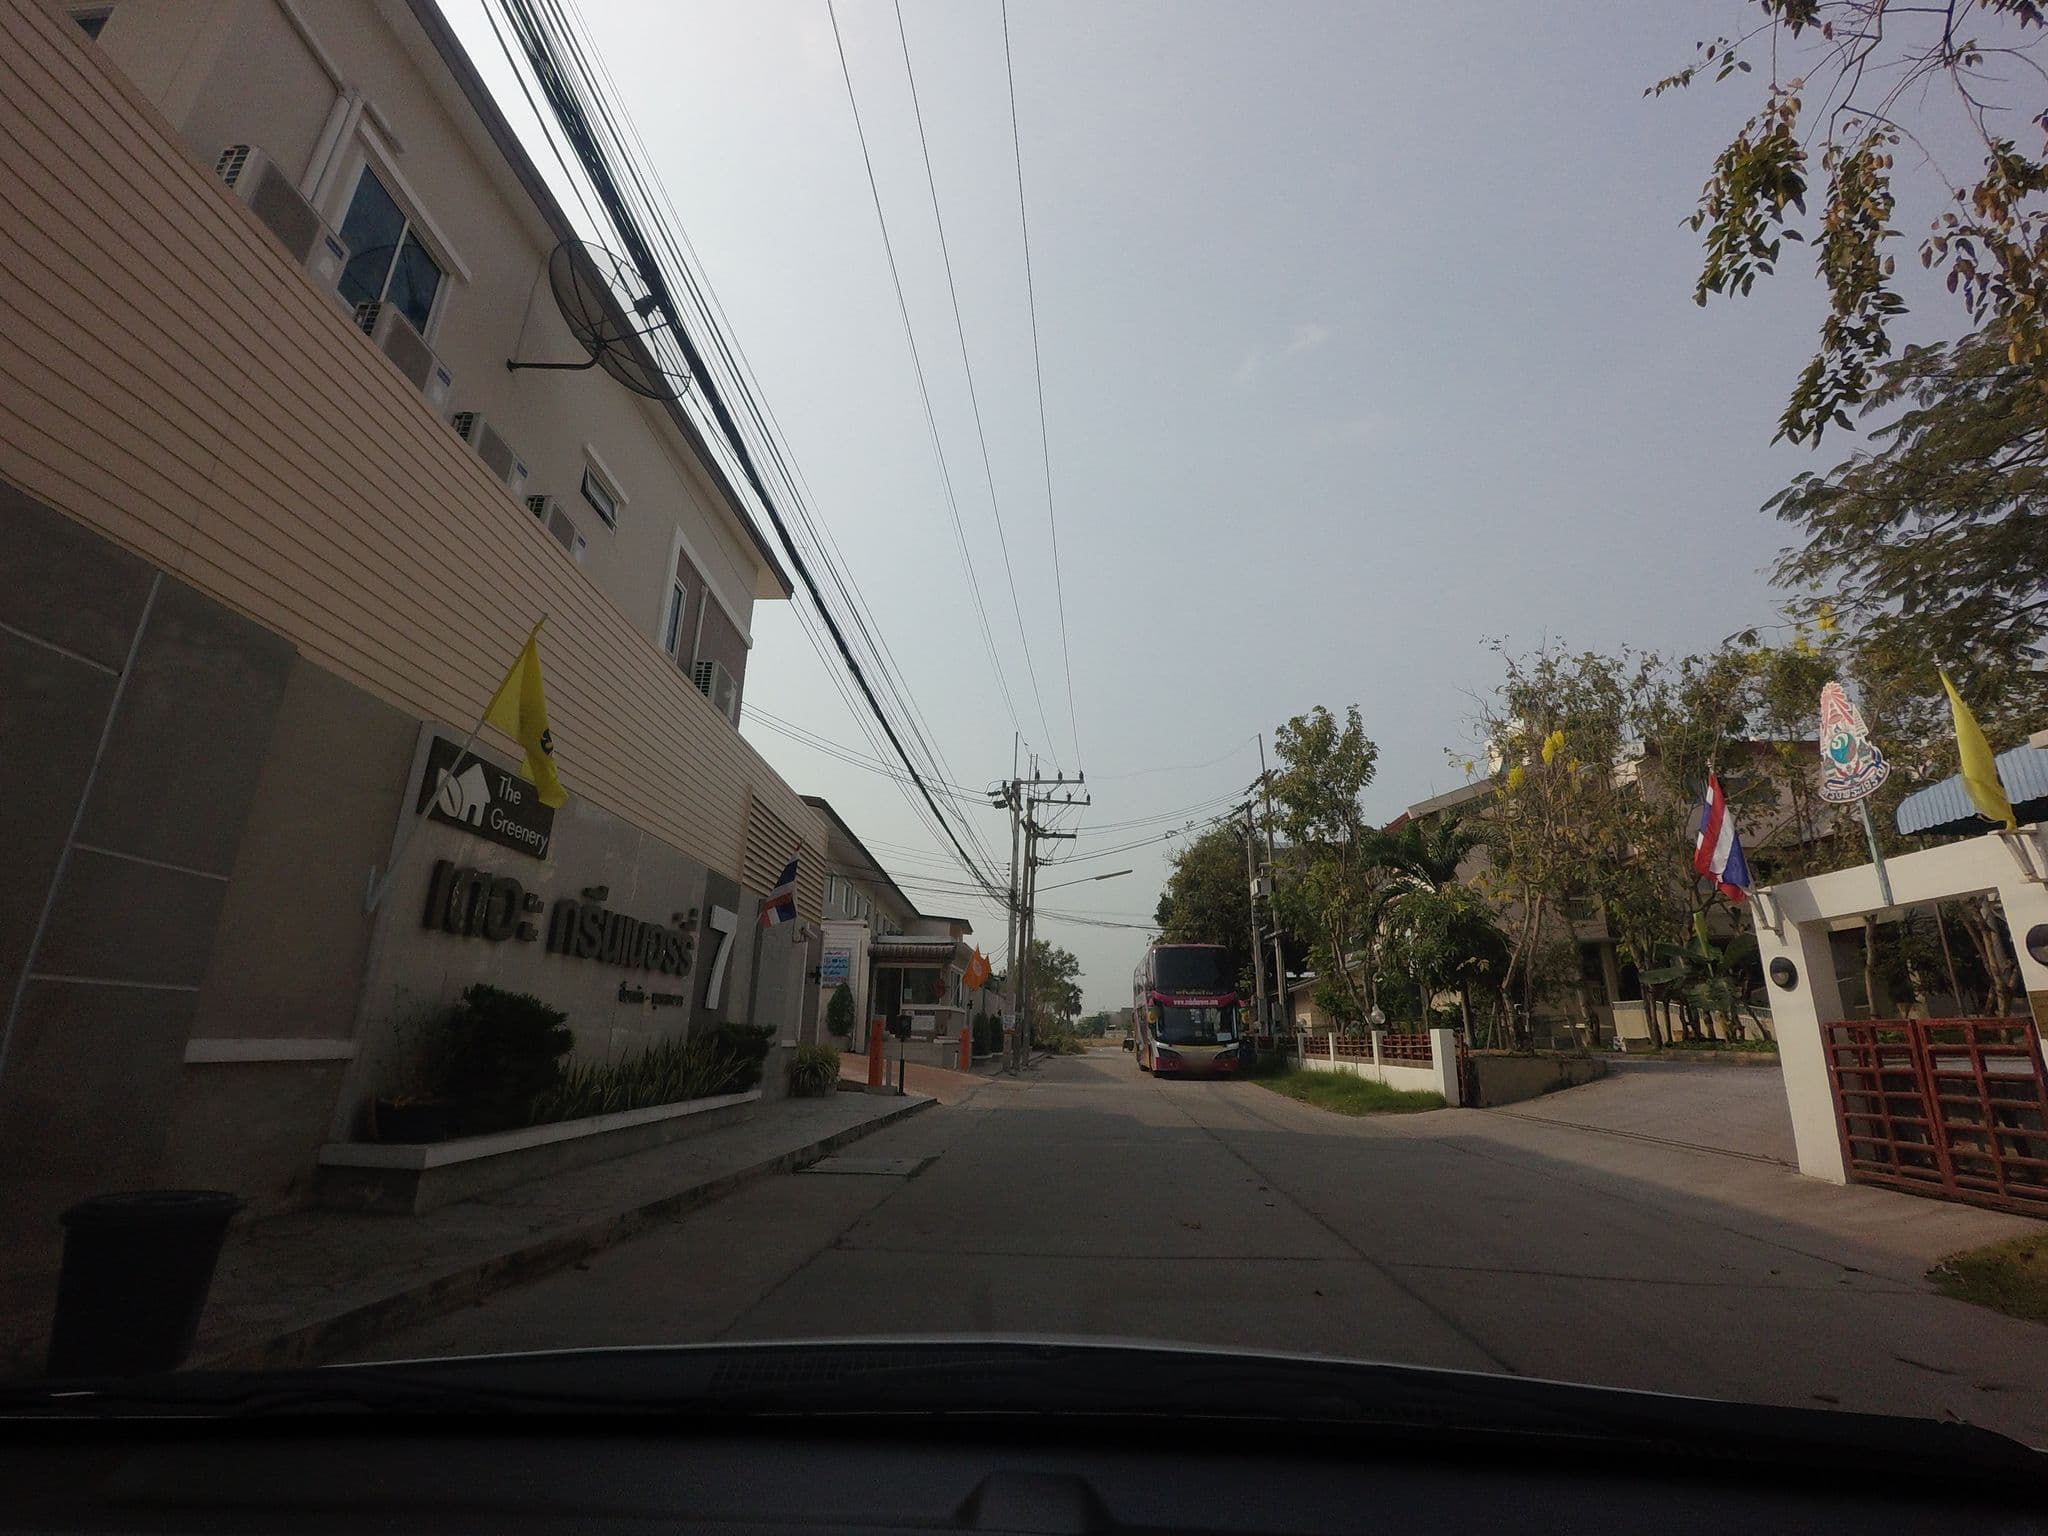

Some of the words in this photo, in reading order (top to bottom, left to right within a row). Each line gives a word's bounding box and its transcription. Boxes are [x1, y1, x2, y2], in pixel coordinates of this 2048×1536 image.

[499, 776, 522, 805] The
[490, 808, 549, 856] Greenery
[422, 859, 544, 942] เดอะ
[546, 885, 699, 977] กรีนเนอรี่
[706, 905, 738, 1010] 7
